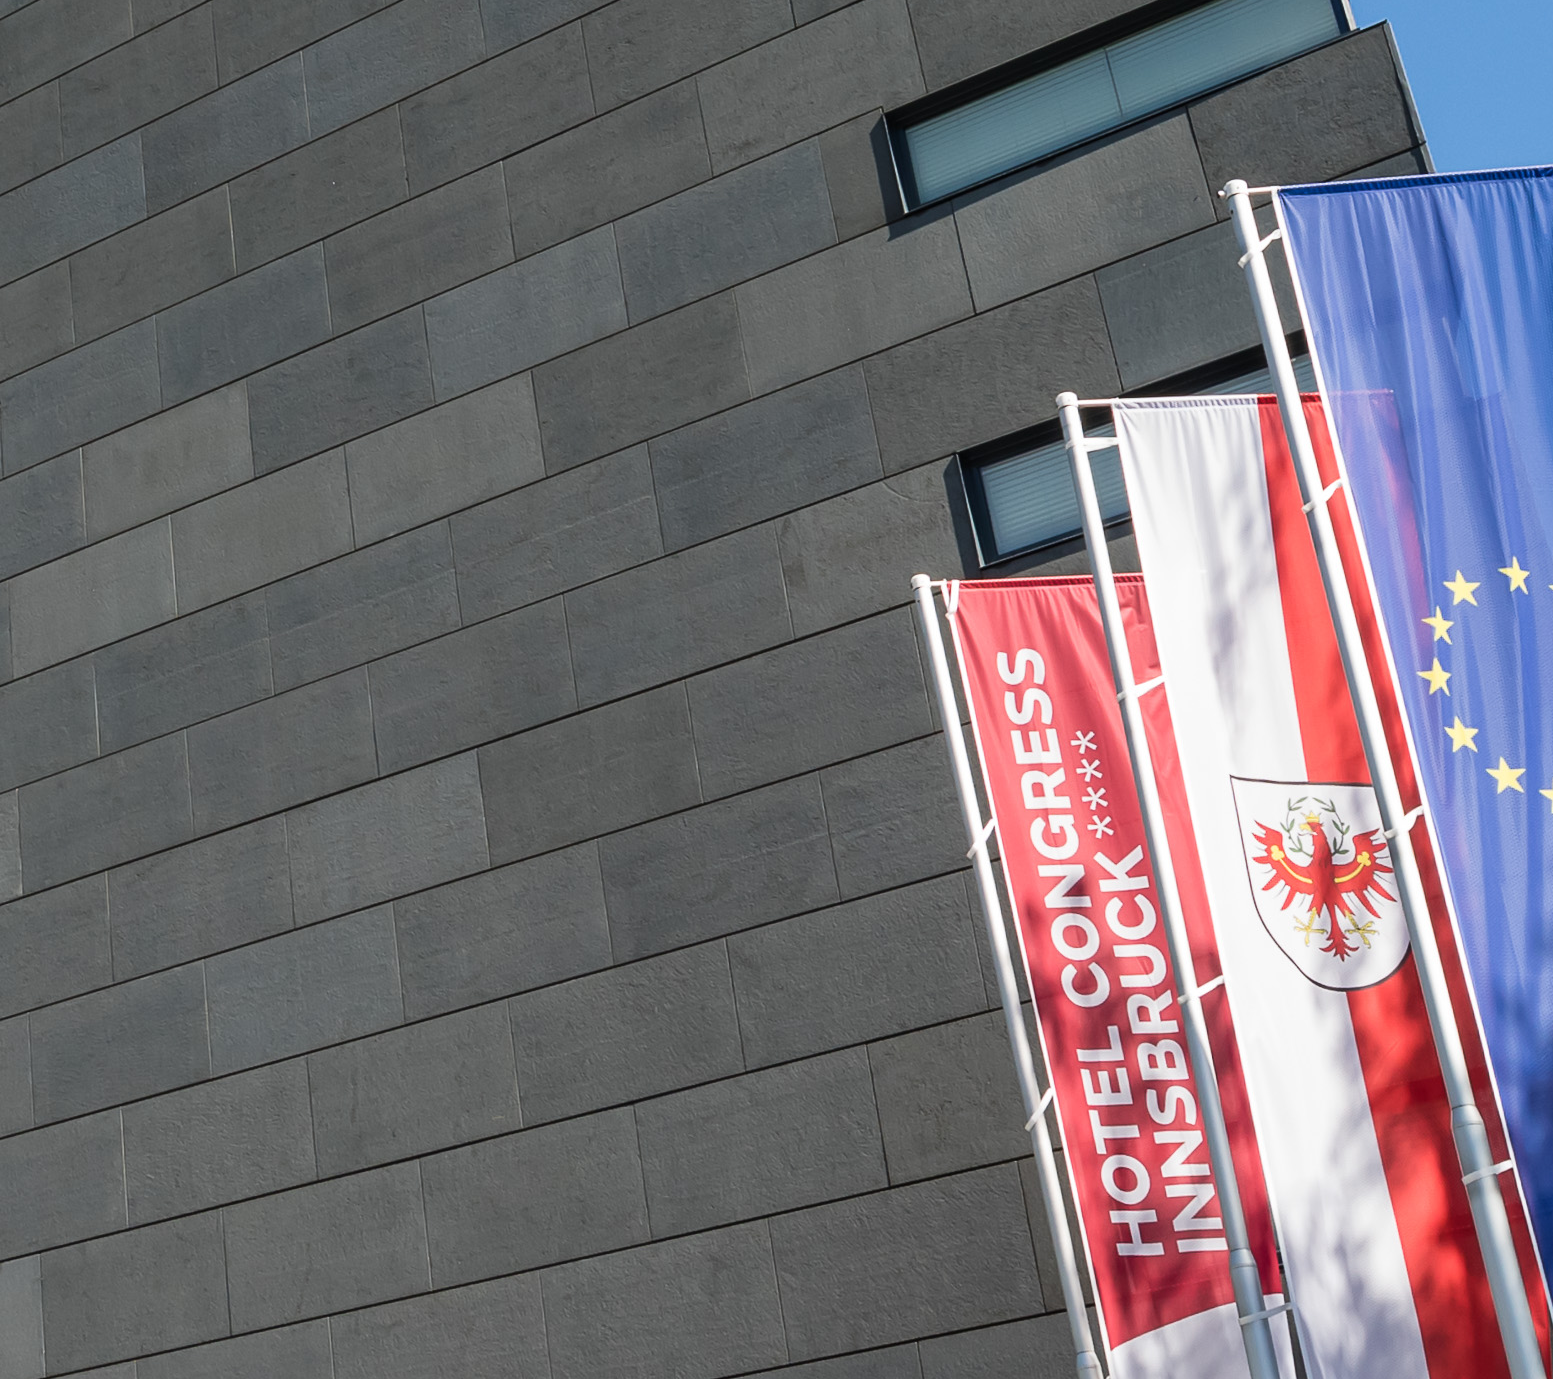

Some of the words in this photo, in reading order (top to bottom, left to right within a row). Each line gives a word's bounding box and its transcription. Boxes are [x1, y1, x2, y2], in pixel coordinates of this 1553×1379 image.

[996, 647, 1111, 1008] CONGRESS
[1076, 1025, 1166, 1257] HOTEL
[1093, 844, 1229, 1254] INNSBRUCK
